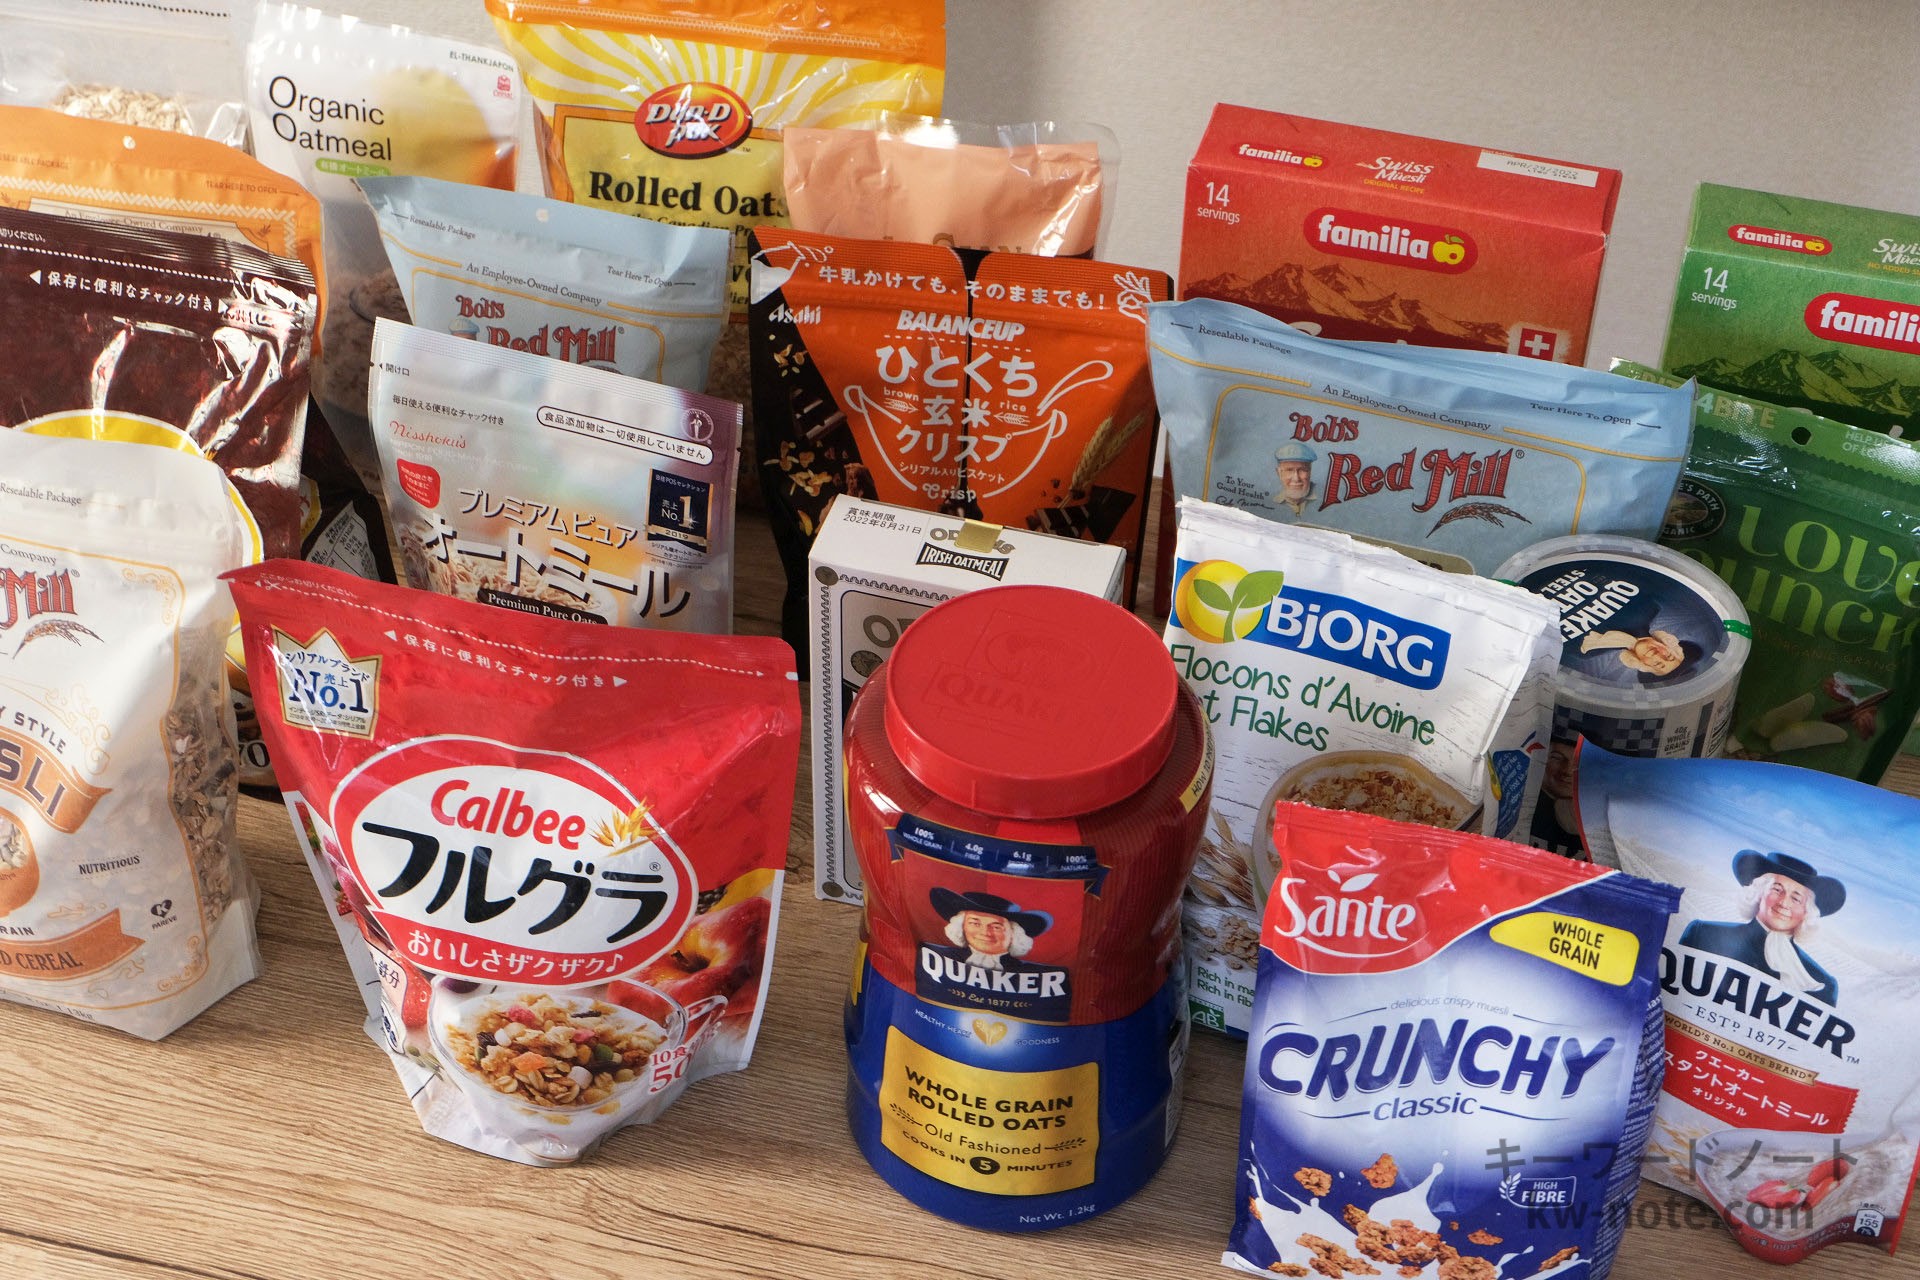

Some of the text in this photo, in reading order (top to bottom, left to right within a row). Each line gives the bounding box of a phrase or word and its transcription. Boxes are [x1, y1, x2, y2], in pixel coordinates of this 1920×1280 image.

[269, 76, 385, 125] Organic
[272, 112, 392, 162] Oatmeal
[1238, 143, 1303, 167] familia
[1367, 156, 1435, 175] Swiss
[588, 171, 702, 212] Rolled
[1204, 181, 1230, 208] 14
[409, 215, 477, 240] Resealable Package
[1197, 205, 1241, 226] servings
[1317, 214, 1430, 260] familia
[1735, 227, 1804, 249] familia
[466, 261, 603, 306] An Employee-Owned Company
[608, 265, 623, 277] Tear
[623, 270, 637, 280] Here
[637, 273, 652, 282] To
[1703, 266, 1730, 293] 14
[47, 270, 213, 312] 保存に便利なチャック付き
[1691, 290, 1738, 310] servings
[456, 295, 505, 319] Bob's
[768, 304, 822, 326] Asahi
[895, 309, 1026, 343] BALANCEUP
[1198, 322, 1293, 355] Resealable Package
[385, 362, 411, 377] 開け口
[876, 345, 1039, 399] ひとくち
[883, 386, 920, 402] brown
[999, 401, 1027, 413] rice
[1322, 383, 1491, 432] An Employee-Owned Company
[393, 393, 505, 426] 毎日使える便利なチャック付き
[921, 395, 992, 429] 玄米
[1529, 401, 1632, 426] Tear Here To Open
[544, 411, 707, 460] 食品添加物は一切使用していません
[1289, 411, 1360, 442] Bob's
[896, 424, 1013, 464] クリスプ
[922, 482, 978, 503] Crisp
[1216, 482, 1241, 495] Good
[1225, 475, 1255, 490] To Your
[1317, 446, 1418, 512] Red
[46, 490, 82, 506] Package
[661, 499, 678, 511] 売上
[459, 487, 638, 550] プレミアムピュア
[677, 495, 695, 530] 1
[842, 514, 923, 535] 2022年8月31日
[847, 506, 896, 523] 賞味期限
[664, 529, 689, 540] 2019
[0, 543, 58, 566] Company
[424, 513, 691, 619] オートミール
[920, 545, 1005, 579] IRISH OATMEAL
[488, 592, 570, 621] Premium Pure
[1560, 579, 1640, 643] QUAKE
[285, 651, 370, 682] シリアルブランド
[403, 634, 605, 689] 保存に便利なチャック付き
[323, 673, 349, 688] 売上
[1230, 695, 1330, 751] Flakes
[1301, 675, 1435, 746] d'Avoine
[14, 711, 67, 755] STYLE
[1190, 770, 1208, 796] HOW
[430, 779, 586, 851] Calbee
[903, 832, 943, 851] WHOLE GRAIN
[914, 827, 935, 841] 100%
[964, 843, 984, 855] 4.0g
[1013, 850, 1033, 862] 6.1g
[1065, 855, 1088, 864] 100%
[78, 854, 141, 876] NUTRITIOUS
[1060, 864, 1090, 872] NATURAL
[362, 822, 668, 944] フルグラ
[151, 914, 178, 930] PAREVE
[1274, 877, 1417, 942] Sante
[1551, 920, 1606, 950] WHOLE
[15, 951, 83, 971] CEREAL
[1548, 936, 1601, 971] GRAIN
[920, 946, 1067, 999] QUAKER
[1197, 966, 1235, 990] Rich in
[987, 998, 1011, 1008] 1877
[1197, 979, 1235, 1002] Rich in
[1657, 945, 1857, 1060] QUAKER
[915, 1008, 947, 1028] HEALTHY
[1390, 995, 1510, 1016] delicious crispy muesli
[1015, 1036, 1060, 1047] GOODNESS
[1664, 1016, 1767, 1067] WORLD'S No.1 OATS
[1745, 1027, 1787, 1051] 1877
[1257, 1017, 1617, 1102] CRUNCHY
[1695, 1049, 1765, 1086] クエーカー
[904, 1065, 1074, 1114] WHOLE GRAIN
[1691, 1085, 1748, 1118] オリジナル
[907, 1086, 1067, 1131] ROLLED OATS
[1373, 1092, 1478, 1122] classic
[902, 1130, 1074, 1173] COOKS IN 5 MINUTES
[925, 1123, 1042, 1156] Old Fashioned
[1521, 1190, 1567, 1204] FIBRE
[1533, 1181, 1558, 1191] HIGH
[1019, 1203, 1096, 1224] Net Wt. 1.2kg
[1858, 1217, 1880, 1229] 155
